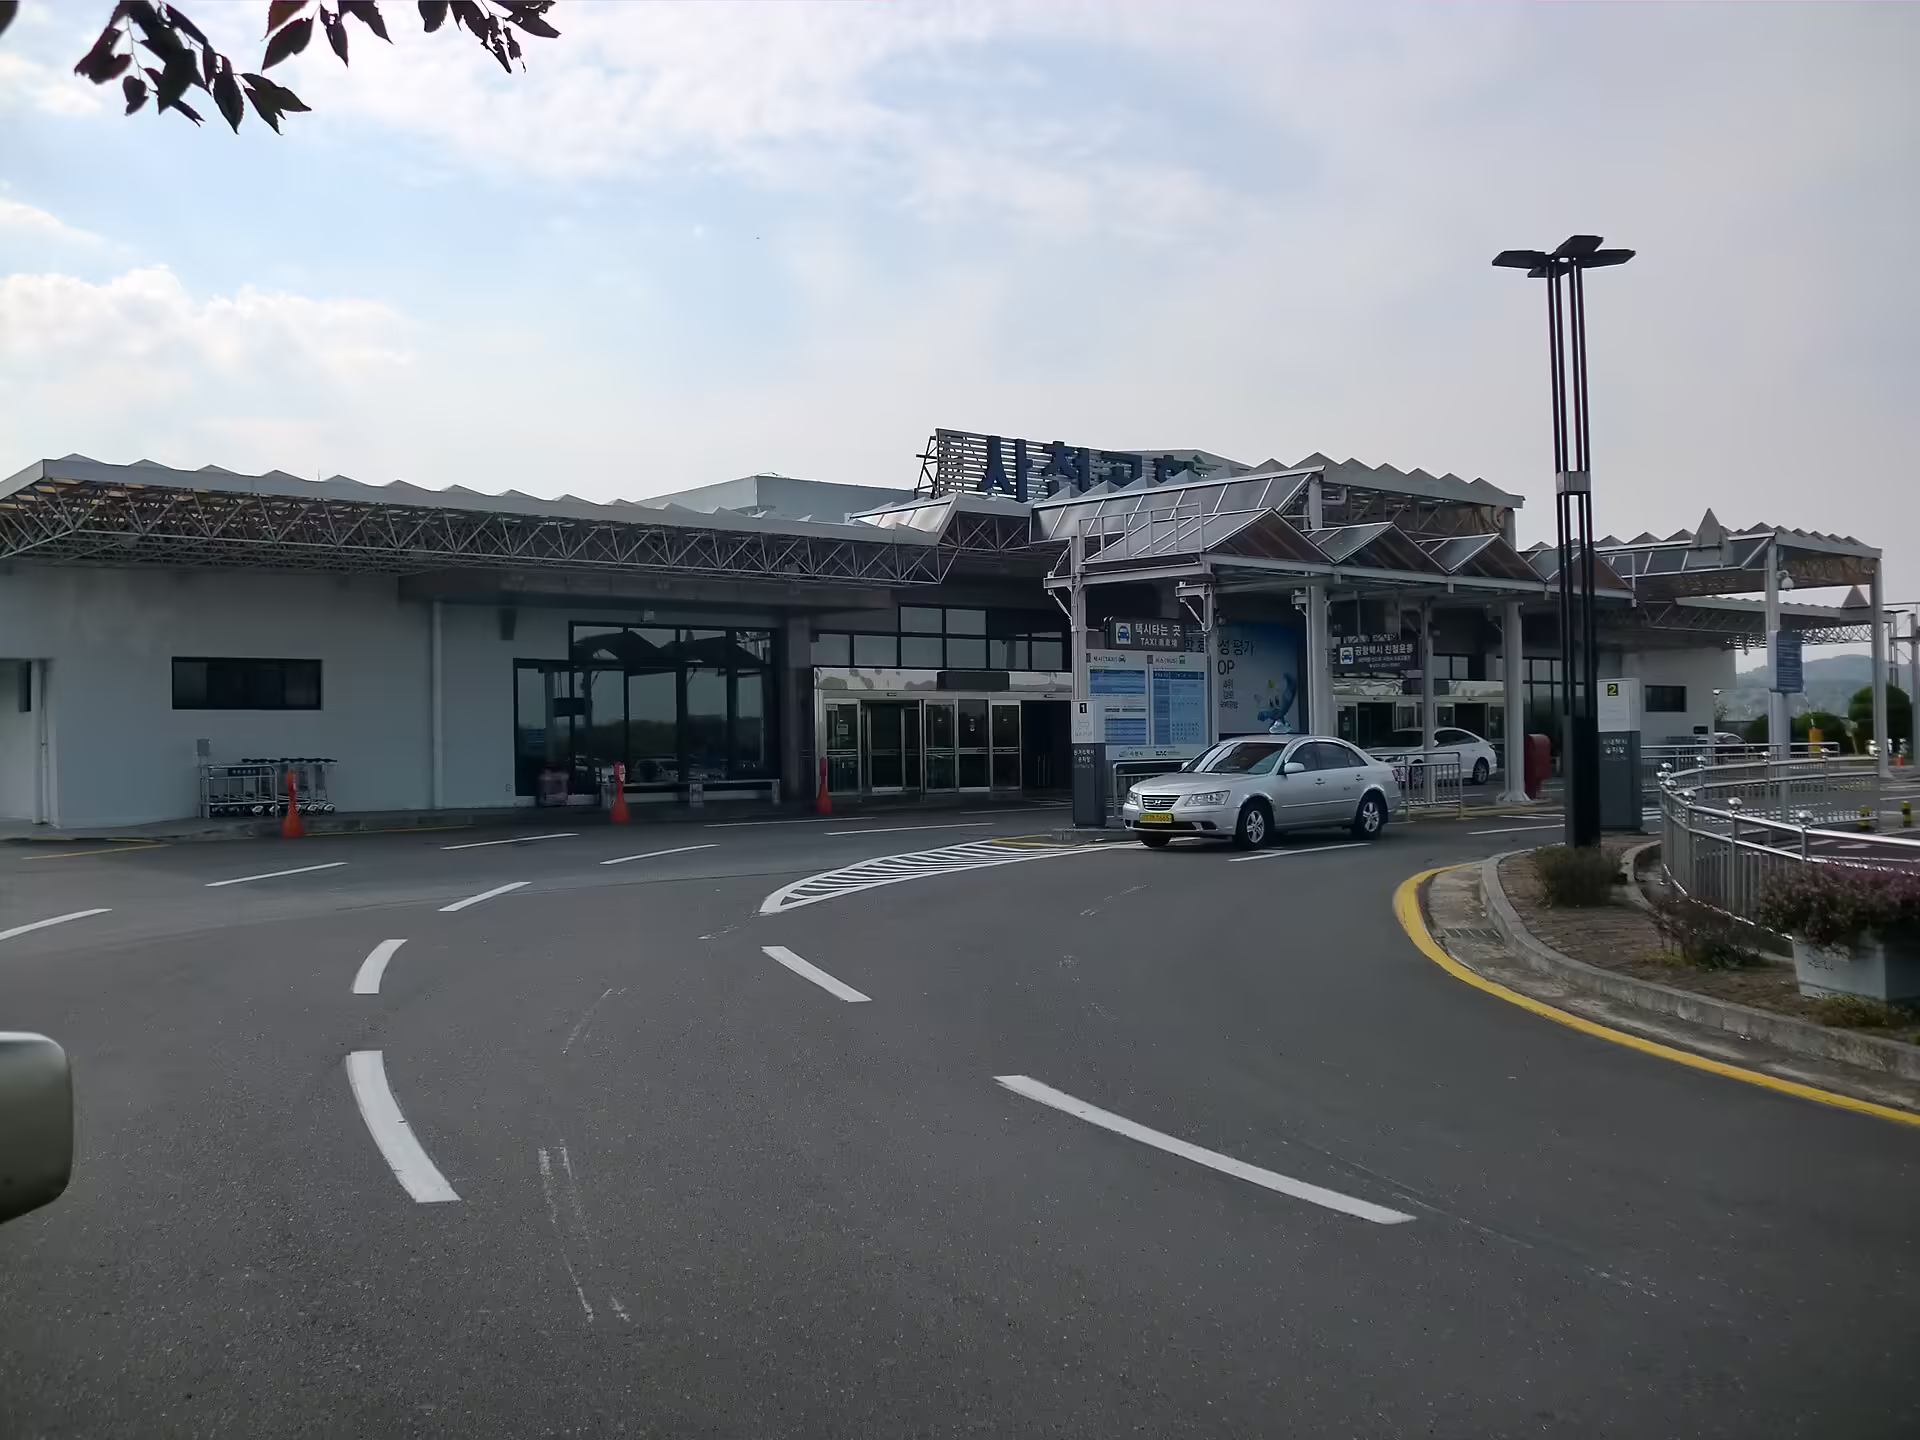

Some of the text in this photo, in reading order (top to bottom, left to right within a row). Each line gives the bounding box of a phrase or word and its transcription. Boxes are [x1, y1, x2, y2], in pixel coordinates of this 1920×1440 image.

[1135, 623, 1181, 637] 택시타는 곳
[1140, 637, 1157, 646] TAXI
[1354, 645, 1383, 656] 공항택시
[1608, 684, 1617, 696] 2
[1080, 704, 1085, 713] 1
